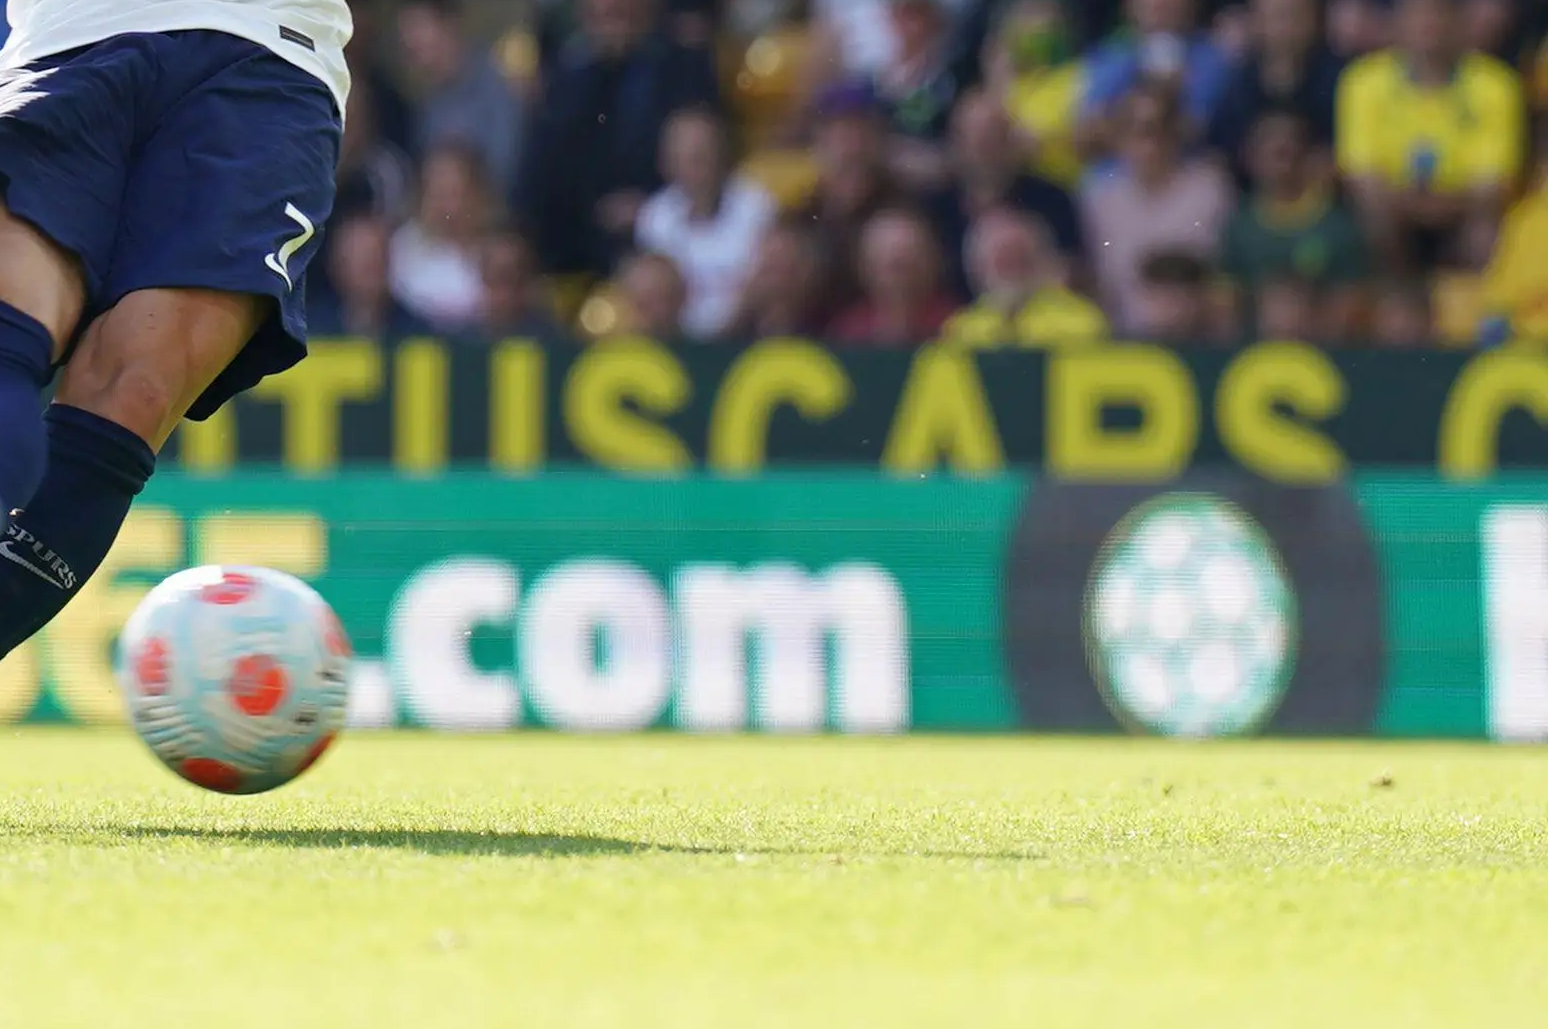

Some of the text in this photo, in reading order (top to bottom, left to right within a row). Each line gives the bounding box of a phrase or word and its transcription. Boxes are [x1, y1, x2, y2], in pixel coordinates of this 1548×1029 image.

[278, 201, 315, 272] 7
[180, 339, 1345, 483] TUSCARS
[5, 523, 78, 589] SPURS
